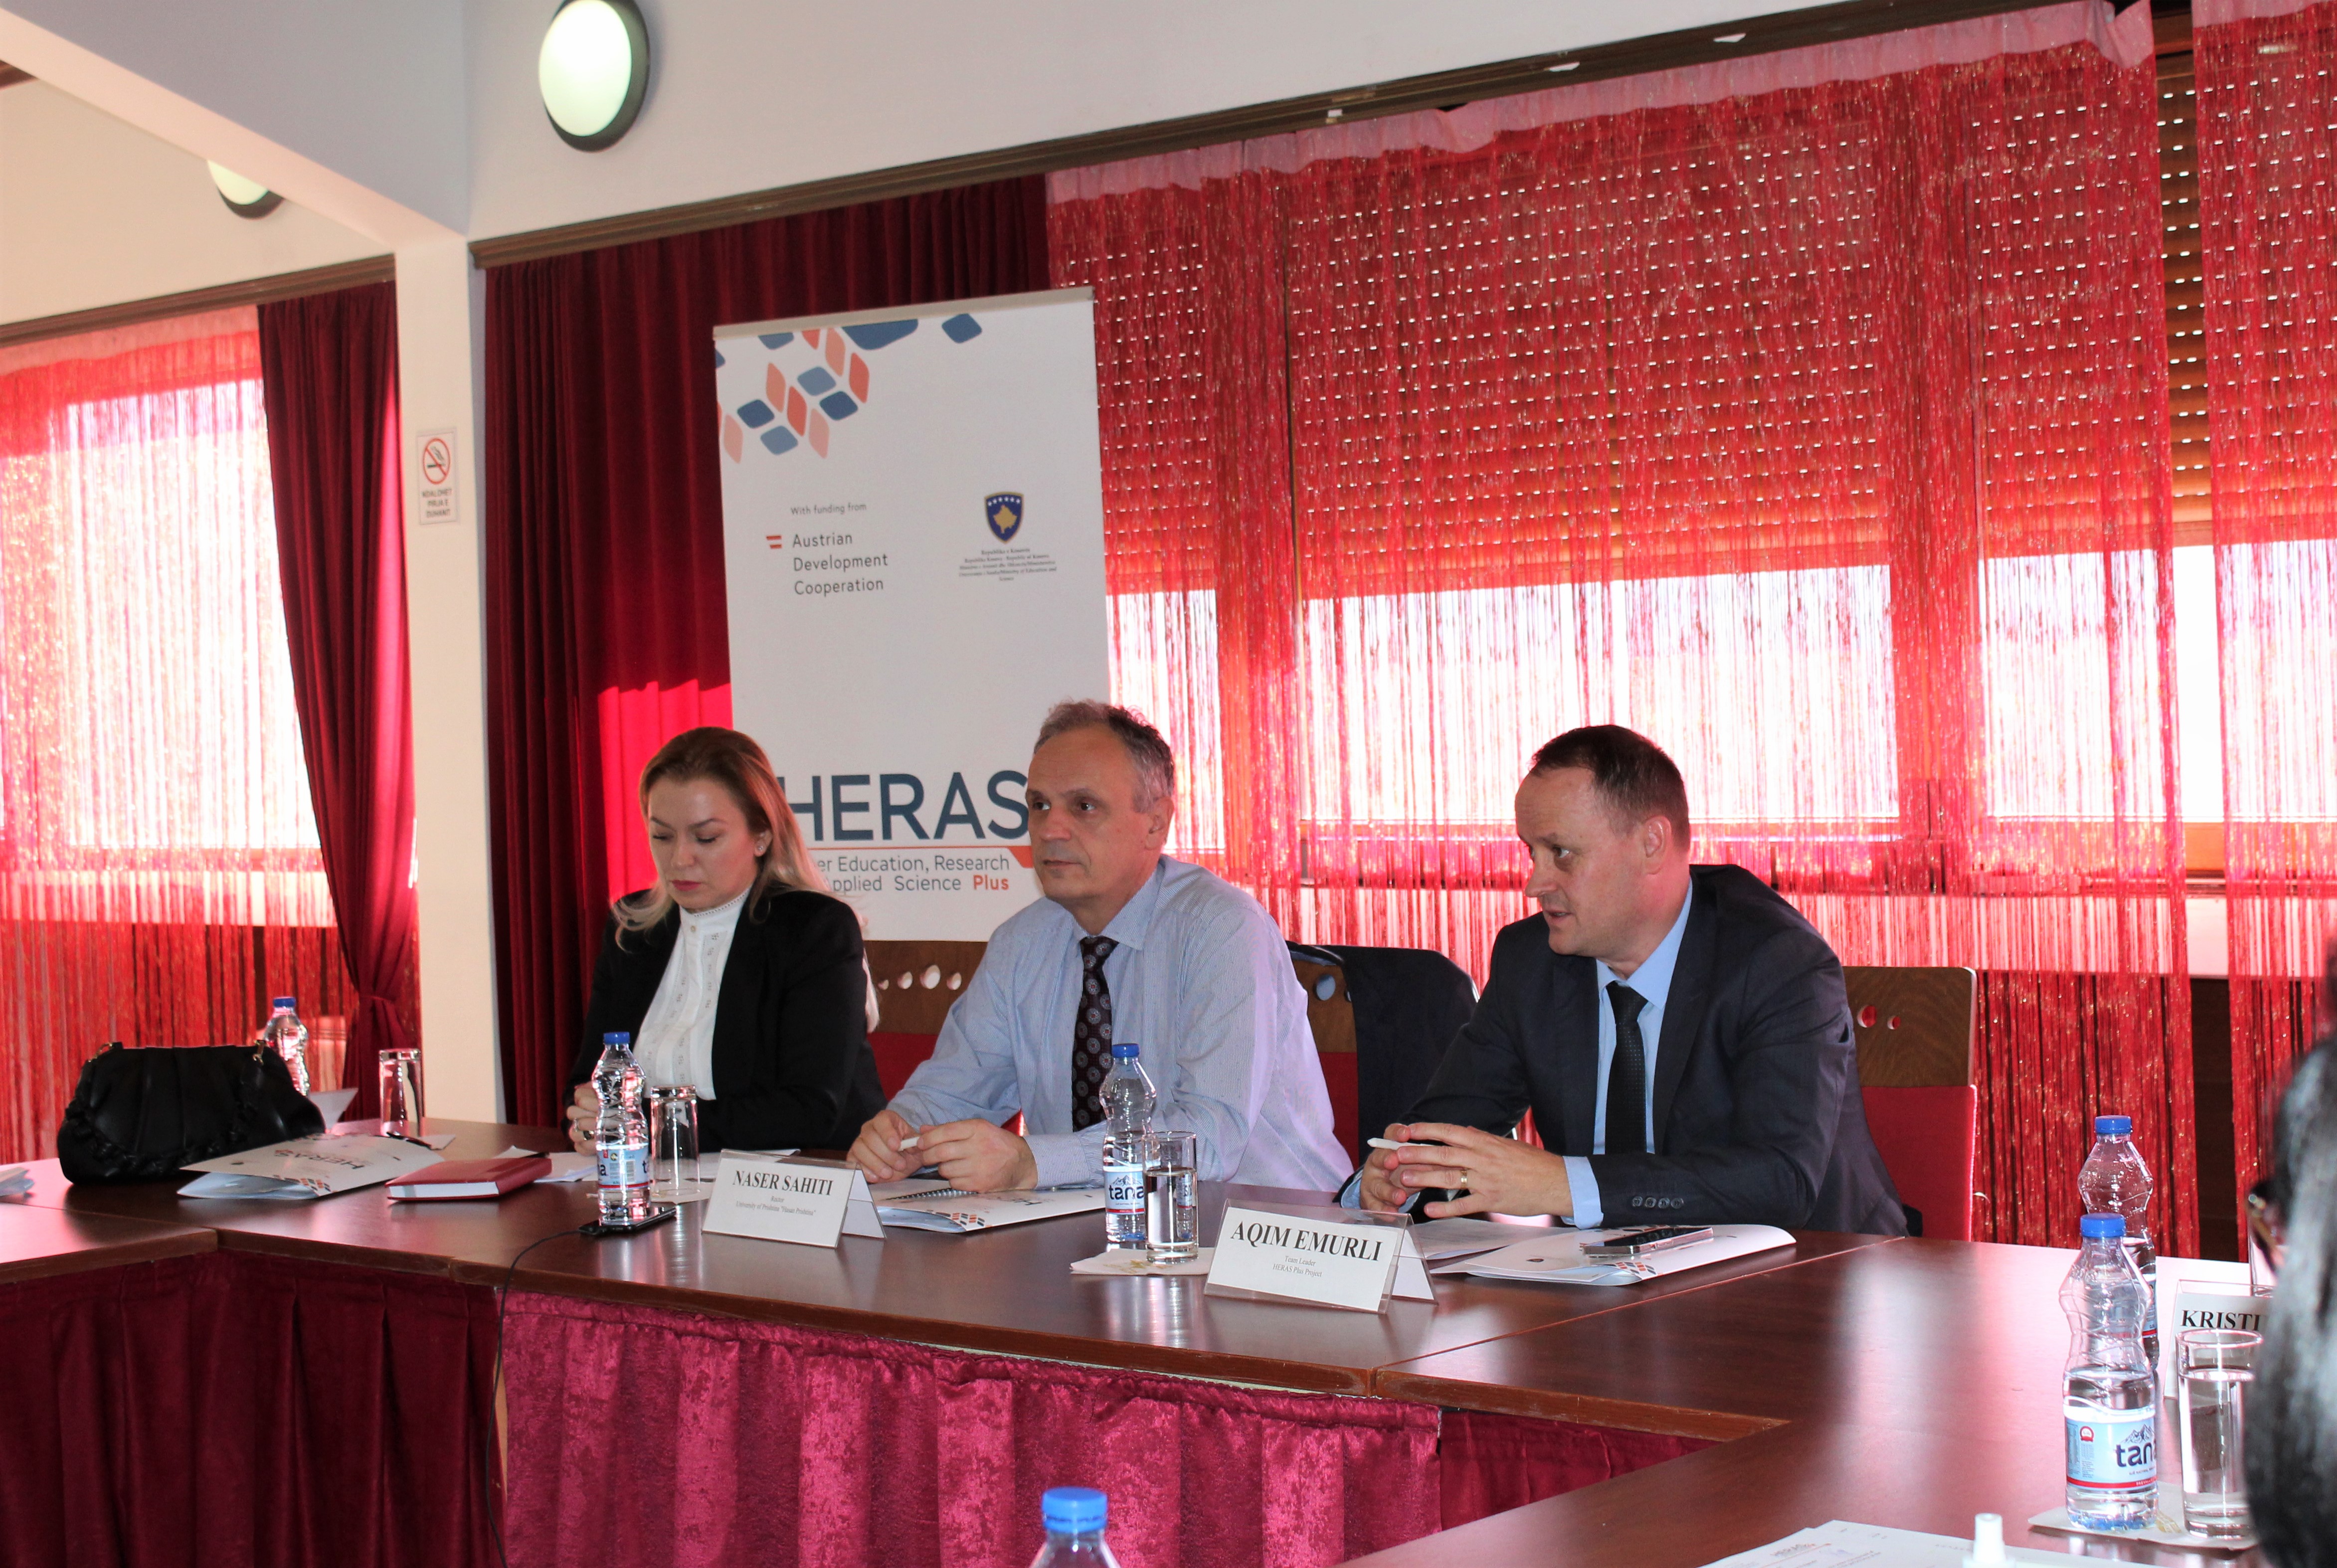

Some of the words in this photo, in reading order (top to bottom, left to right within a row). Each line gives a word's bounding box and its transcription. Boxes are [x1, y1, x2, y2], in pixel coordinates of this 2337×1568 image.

[791, 506, 811, 515] With
[814, 505, 845, 515] funding
[792, 532, 853, 547] Austrian
[793, 553, 888, 572] Development
[794, 578, 884, 597] Cooperation
[777, 770, 1029, 842] HERAS
[838, 856, 929, 873] Education,
[934, 854, 1010, 871] Research
[832, 875, 882, 895] pplied
[895, 875, 961, 891] Science
[973, 874, 1010, 891] Plus
[732, 1170, 780, 1190] NASER
[782, 1175, 834, 1196] SAHITI
[1108, 1185, 1144, 1201] tana
[1230, 1220, 1292, 1247] AQIM
[1292, 1229, 1384, 1261] EMURLI
[1272, 1263, 1293, 1272] HERAS
[1293, 1266, 1304, 1274] Plus
[1304, 1268, 1323, 1278] Project
[1284, 1255, 1298, 1264] Team
[1299, 1257, 1316, 1267] Leader
[2180, 1309, 2263, 1331] KRISTI
